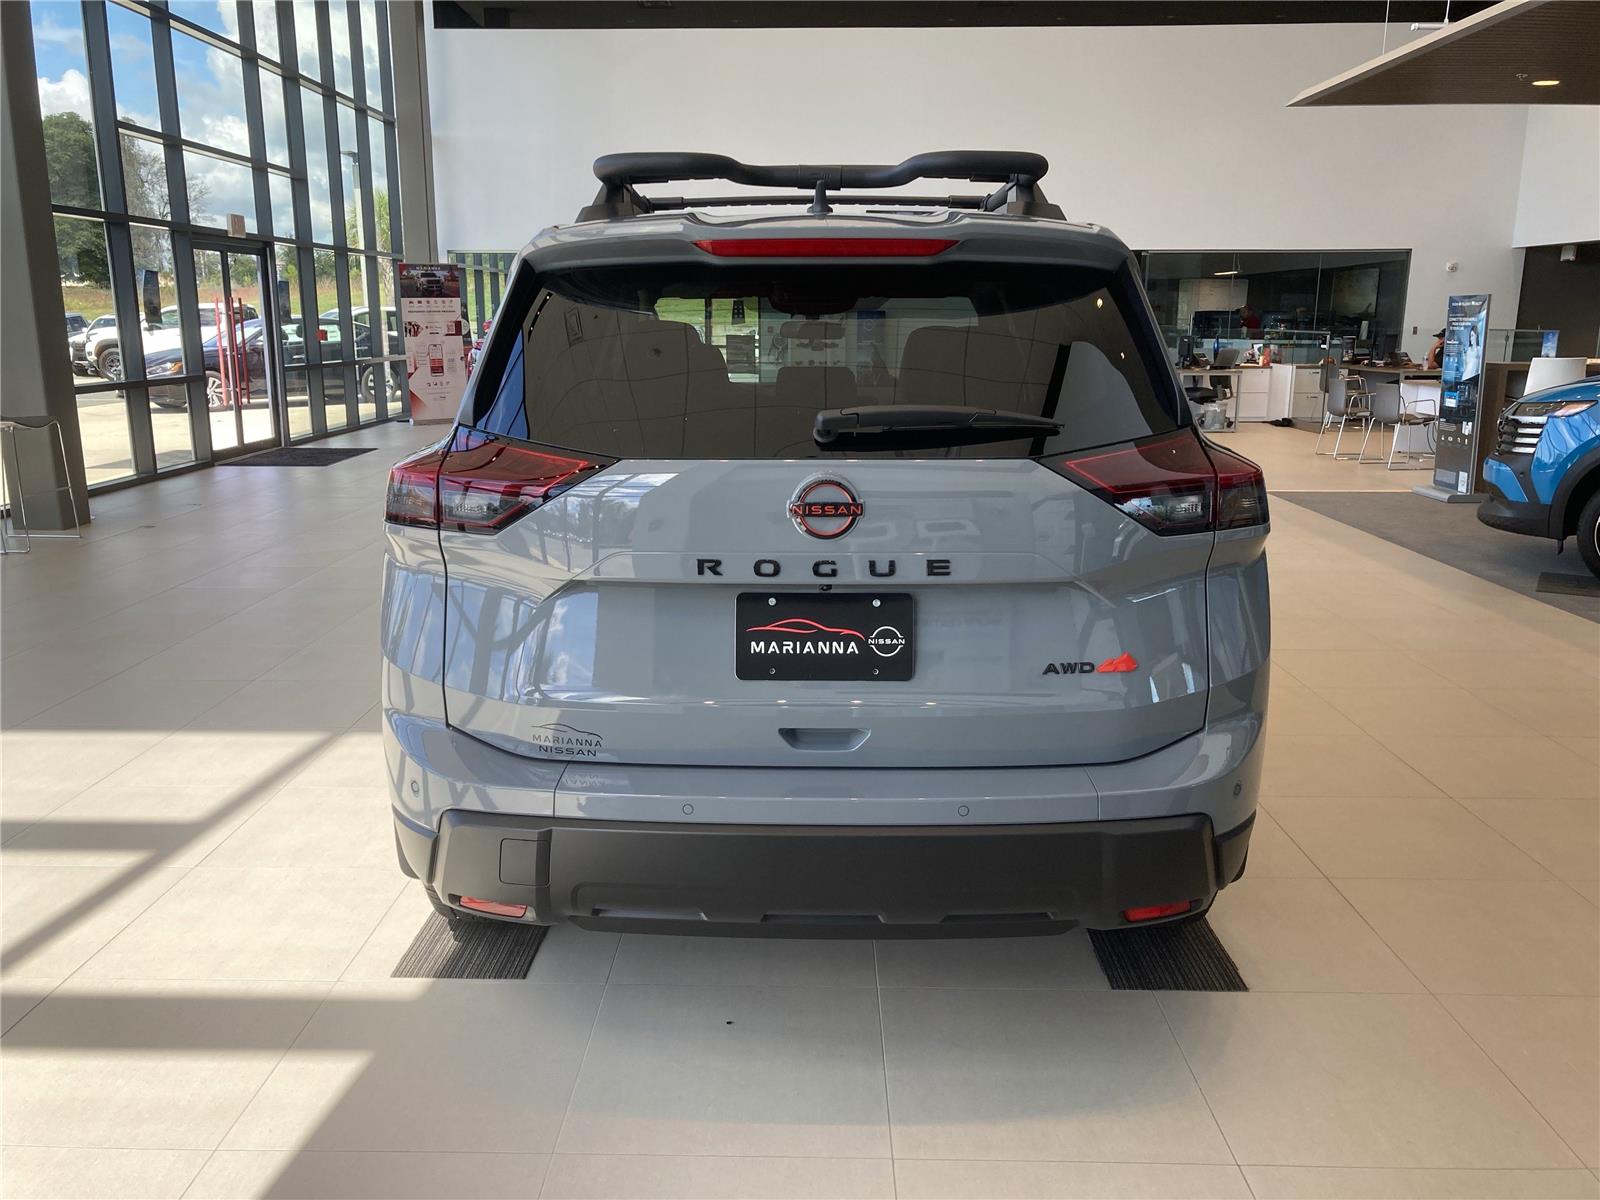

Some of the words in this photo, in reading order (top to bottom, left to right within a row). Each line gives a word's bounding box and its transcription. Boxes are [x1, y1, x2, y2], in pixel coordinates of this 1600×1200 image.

[791, 504, 862, 515] NISSAN
[696, 558, 952, 578] ROGUE
[750, 640, 860, 655] MARIANNA
[1042, 661, 1096, 675] AWD
[532, 733, 602, 748] MARIANNA
[538, 745, 597, 757] NISSAN
